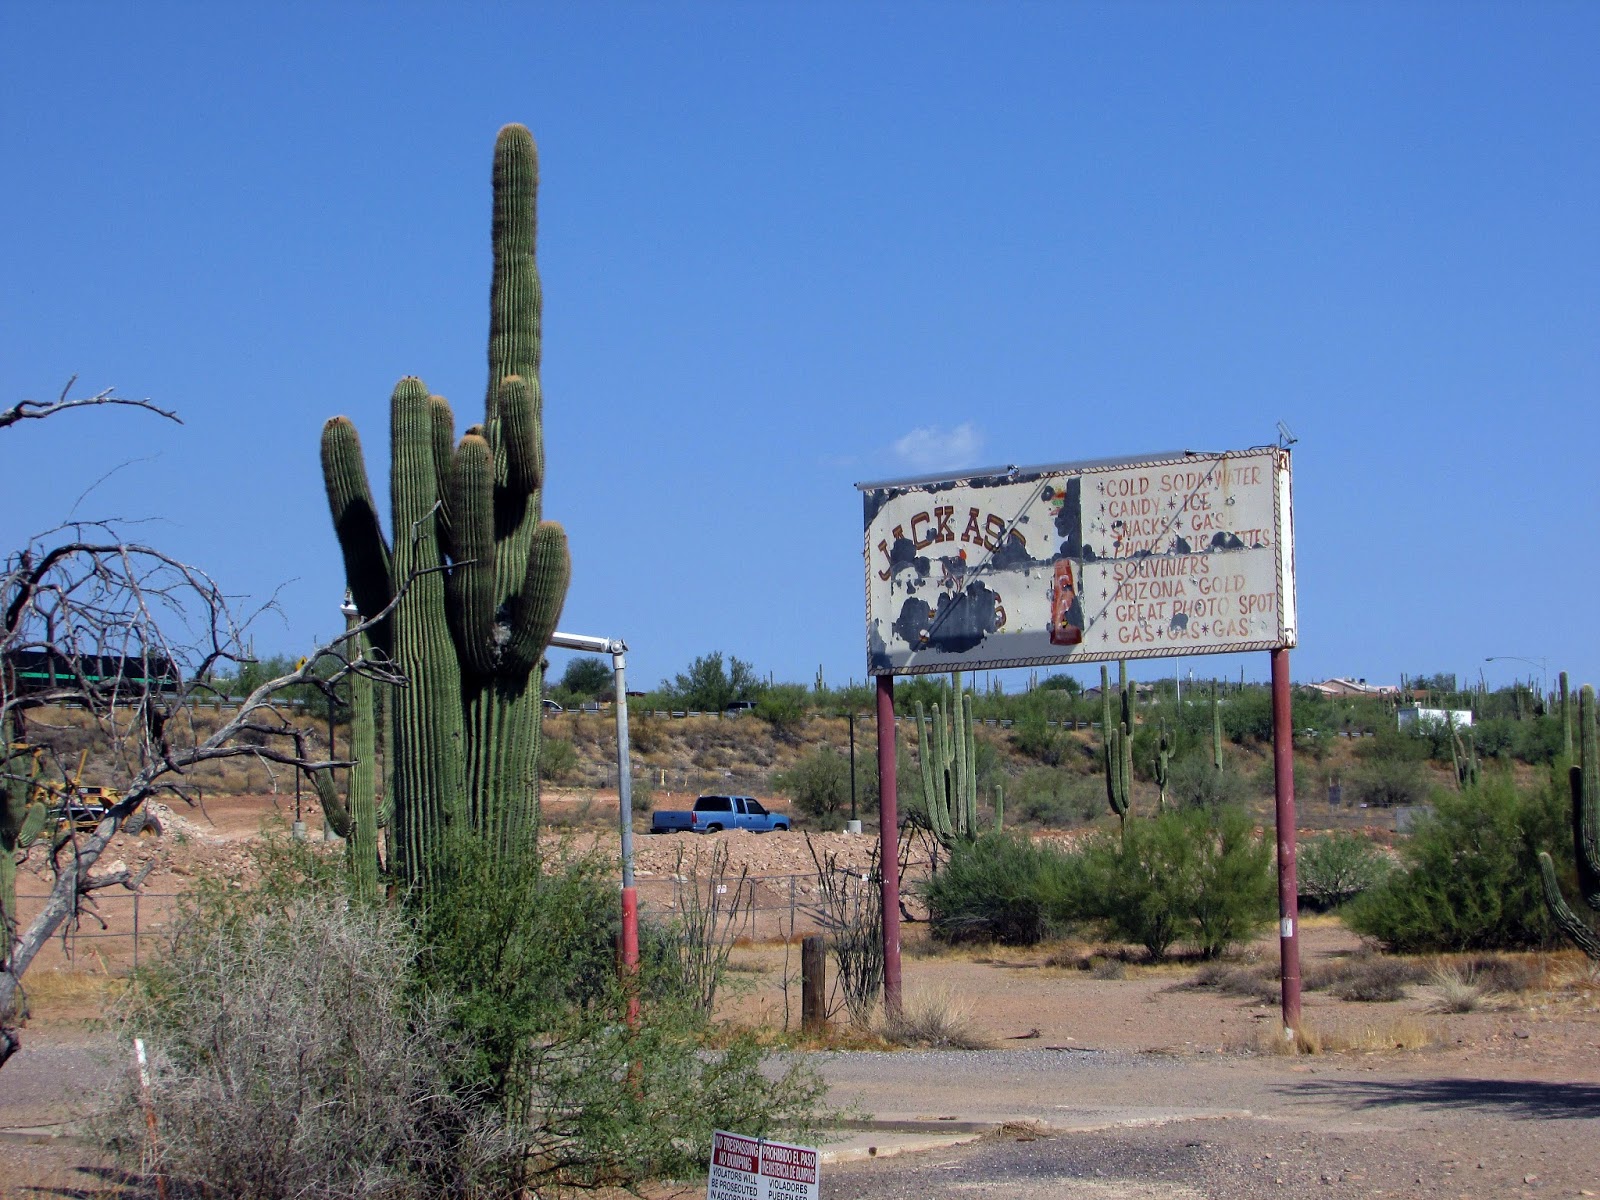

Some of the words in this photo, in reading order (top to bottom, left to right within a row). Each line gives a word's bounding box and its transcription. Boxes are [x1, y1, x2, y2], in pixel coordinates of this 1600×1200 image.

[1106, 477, 1149, 497] COLD
[1160, 472, 1207, 492] SODA
[1214, 466, 1262, 486] WATER
[1108, 497, 1160, 518] CANDY
[1183, 492, 1212, 512] ICE
[1110, 516, 1171, 539] SNACKS
[1191, 512, 1225, 531] GAS
[878, 505, 1027, 582] JCKAS
[1115, 579, 1185, 602] ARIZONA
[1199, 574, 1246, 595] GOLD
[1115, 601, 1166, 623] GREAT
[1172, 597, 1230, 619] PHOTO
[1238, 592, 1276, 615] SPOT
[1118, 625, 1154, 643] GAS
[1166, 621, 1201, 640] GAS
[1212, 617, 1249, 638] GAS
[715, 1135, 723, 1149] NO
[723, 1136, 759, 1157] TRESPASSING
[763, 1145, 792, 1164] PROHIBIDO
[793, 1151, 800, 1165] EL
[800, 1152, 815, 1168] PASO
[719, 1150, 727, 1166] NO
[727, 1152, 752, 1171] DUMPING
[713, 1167, 742, 1182] VIOLATORS
[743, 1174, 758, 1185] WILL
[789, 1165, 796, 1180] DE
[711, 1178, 718, 1188] BE
[720, 1180, 758, 1197] PROSECUTED
[711, 1190, 717, 1199] IN
[717, 1191, 757, 1200] ACCORD
[769, 1178, 808, 1195] VIOLADORES
